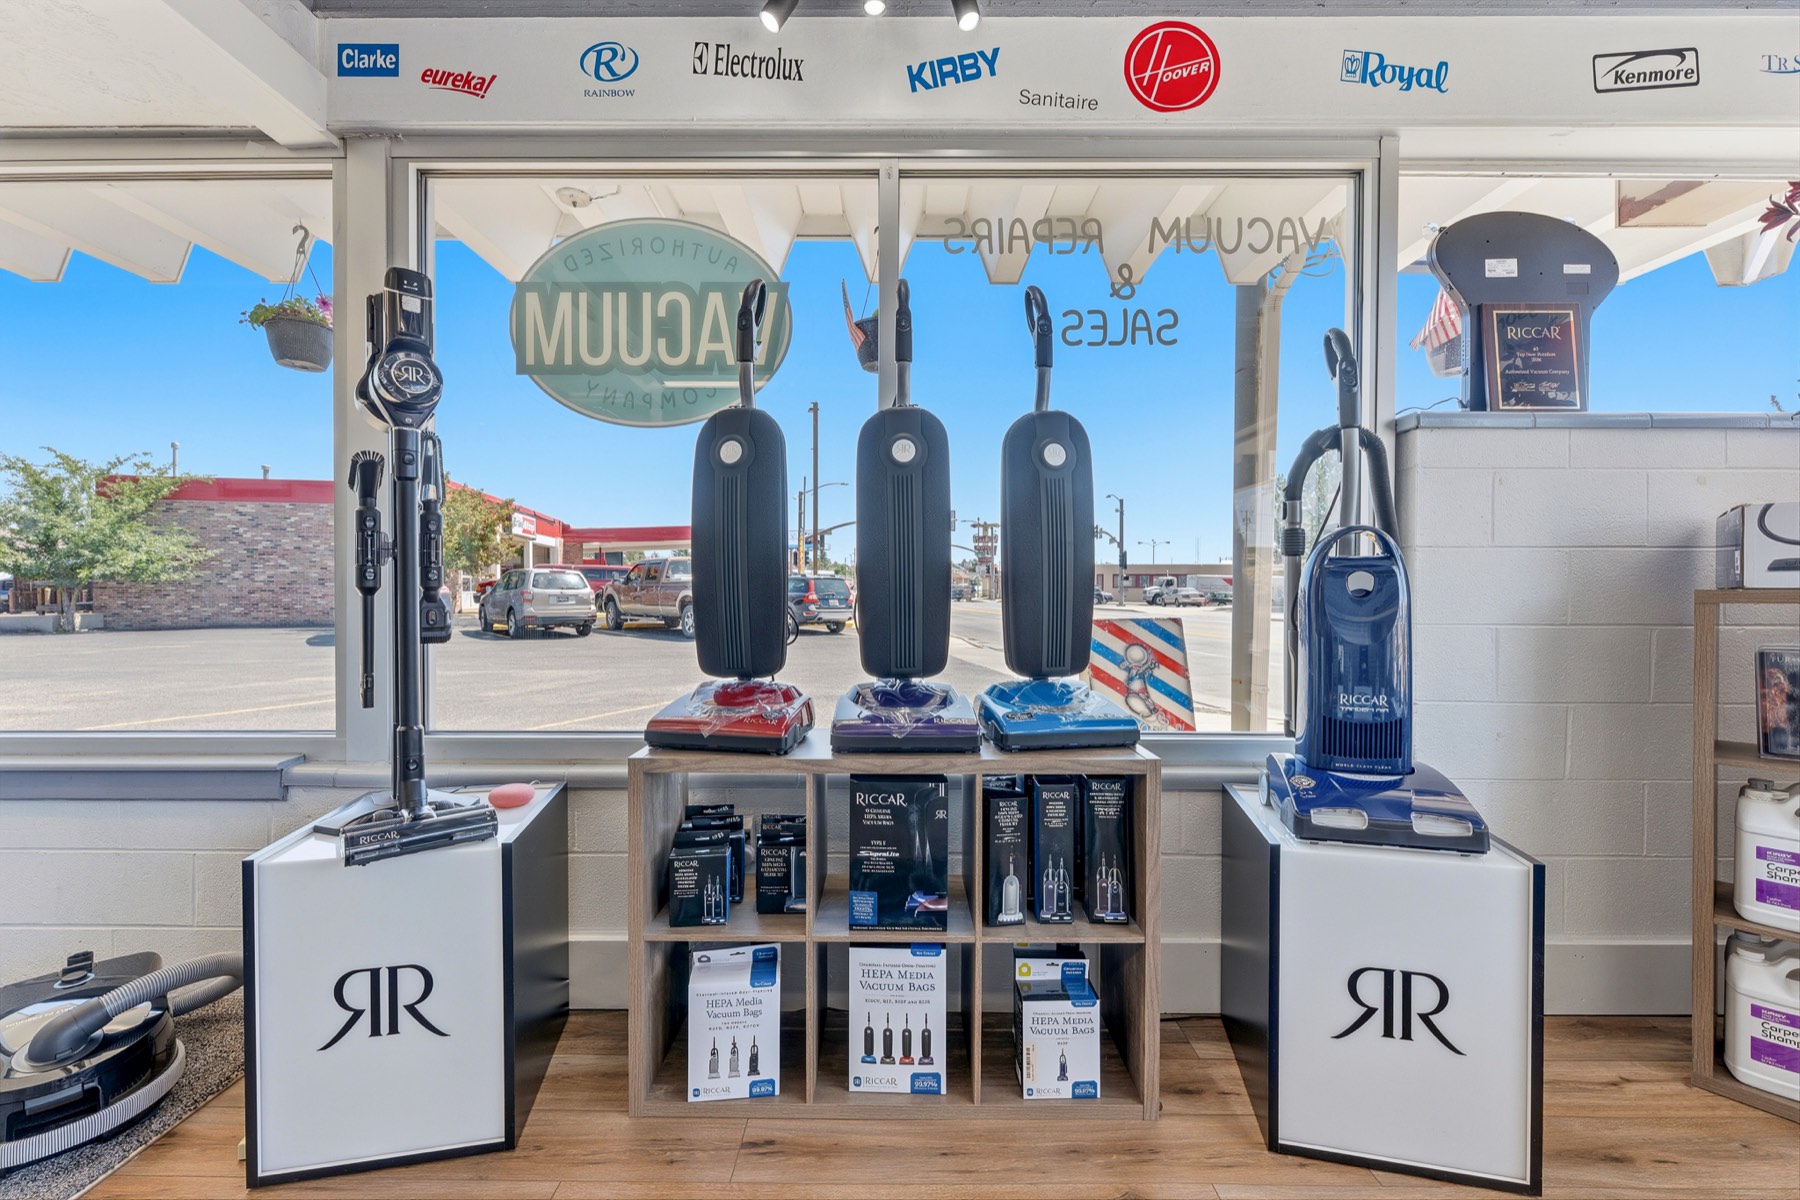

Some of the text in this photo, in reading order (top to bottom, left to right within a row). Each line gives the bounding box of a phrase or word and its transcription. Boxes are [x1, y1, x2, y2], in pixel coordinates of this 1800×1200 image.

[341, 49, 397, 70] Clarke
[712, 43, 805, 82] Electrolux
[906, 46, 1001, 93] KIRBY
[1360, 51, 1449, 94] Royal
[1613, 66, 1695, 86] Kenmore
[420, 67, 498, 100] eureka!
[583, 89, 636, 98] RAINBOW
[1018, 88, 1099, 111] Sanitaire
[1507, 326, 1562, 340] RICCAR
[1340, 693, 1389, 708] RICCAR
[743, 717, 779, 726] RICCAR
[1092, 781, 1122, 791] RICCAR
[856, 792, 908, 807] RICCAR
[1042, 791, 1070, 799] RICCAR
[359, 830, 401, 846] RICCAR
[760, 848, 788, 857] RICCAR
[673, 860, 700, 868] RICCAR
[861, 968, 934, 979] HEPA MEDIA
[859, 980, 936, 991] VACUUM BAGS
[706, 996, 763, 1008] HEPA Media
[706, 1008, 763, 1019] Vacuum Bags
[1031, 1017, 1094, 1025] HEPA MEDIA
[1029, 1026, 1095, 1035] VACUUM BAGS
[865, 1076, 898, 1085] RICCAR
[703, 1086, 731, 1094] RICCAR
